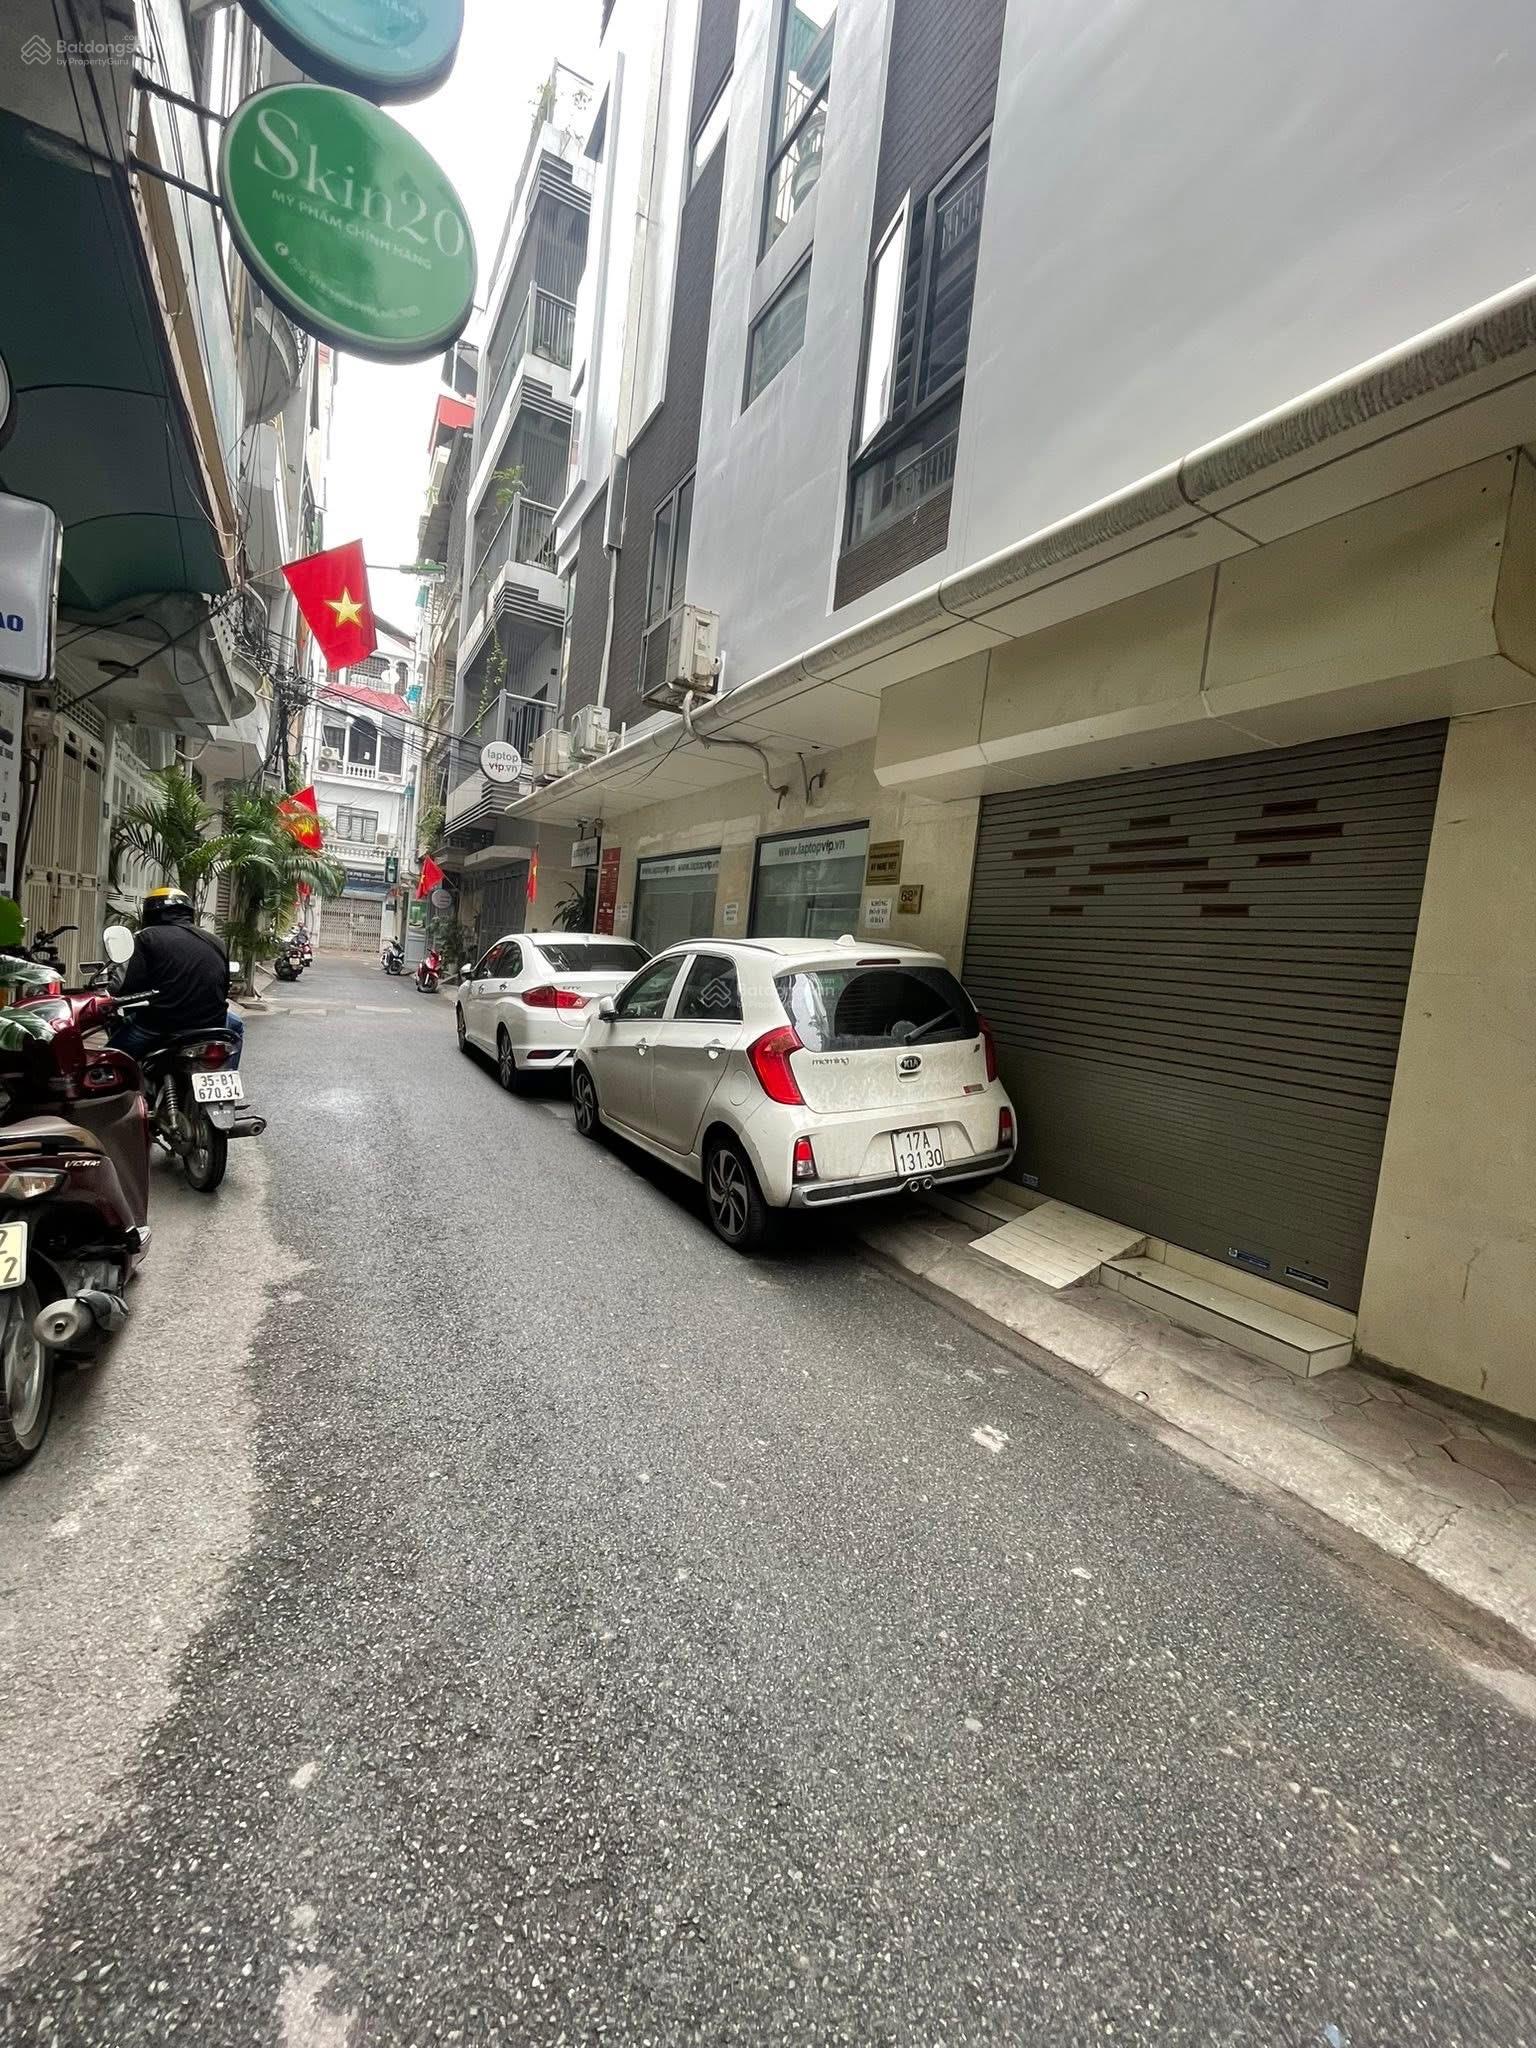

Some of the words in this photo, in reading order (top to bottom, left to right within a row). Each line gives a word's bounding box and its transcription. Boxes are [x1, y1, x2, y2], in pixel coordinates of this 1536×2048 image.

[254, 108, 465, 257] Skin20
[487, 748, 519, 764] laptop
[488, 761, 518, 773] vip.vn
[778, 838, 846, 858] www.laptopvip.vn
[811, 1056, 850, 1067] morning
[902, 1057, 920, 1069] KIA
[200, 1074, 234, 1087] 35-B1
[198, 1086, 240, 1100] 670.34
[906, 1131, 931, 1151] 17A
[899, 1149, 944, 1173] 131.30
[3, 1256, 18, 1284] 2
